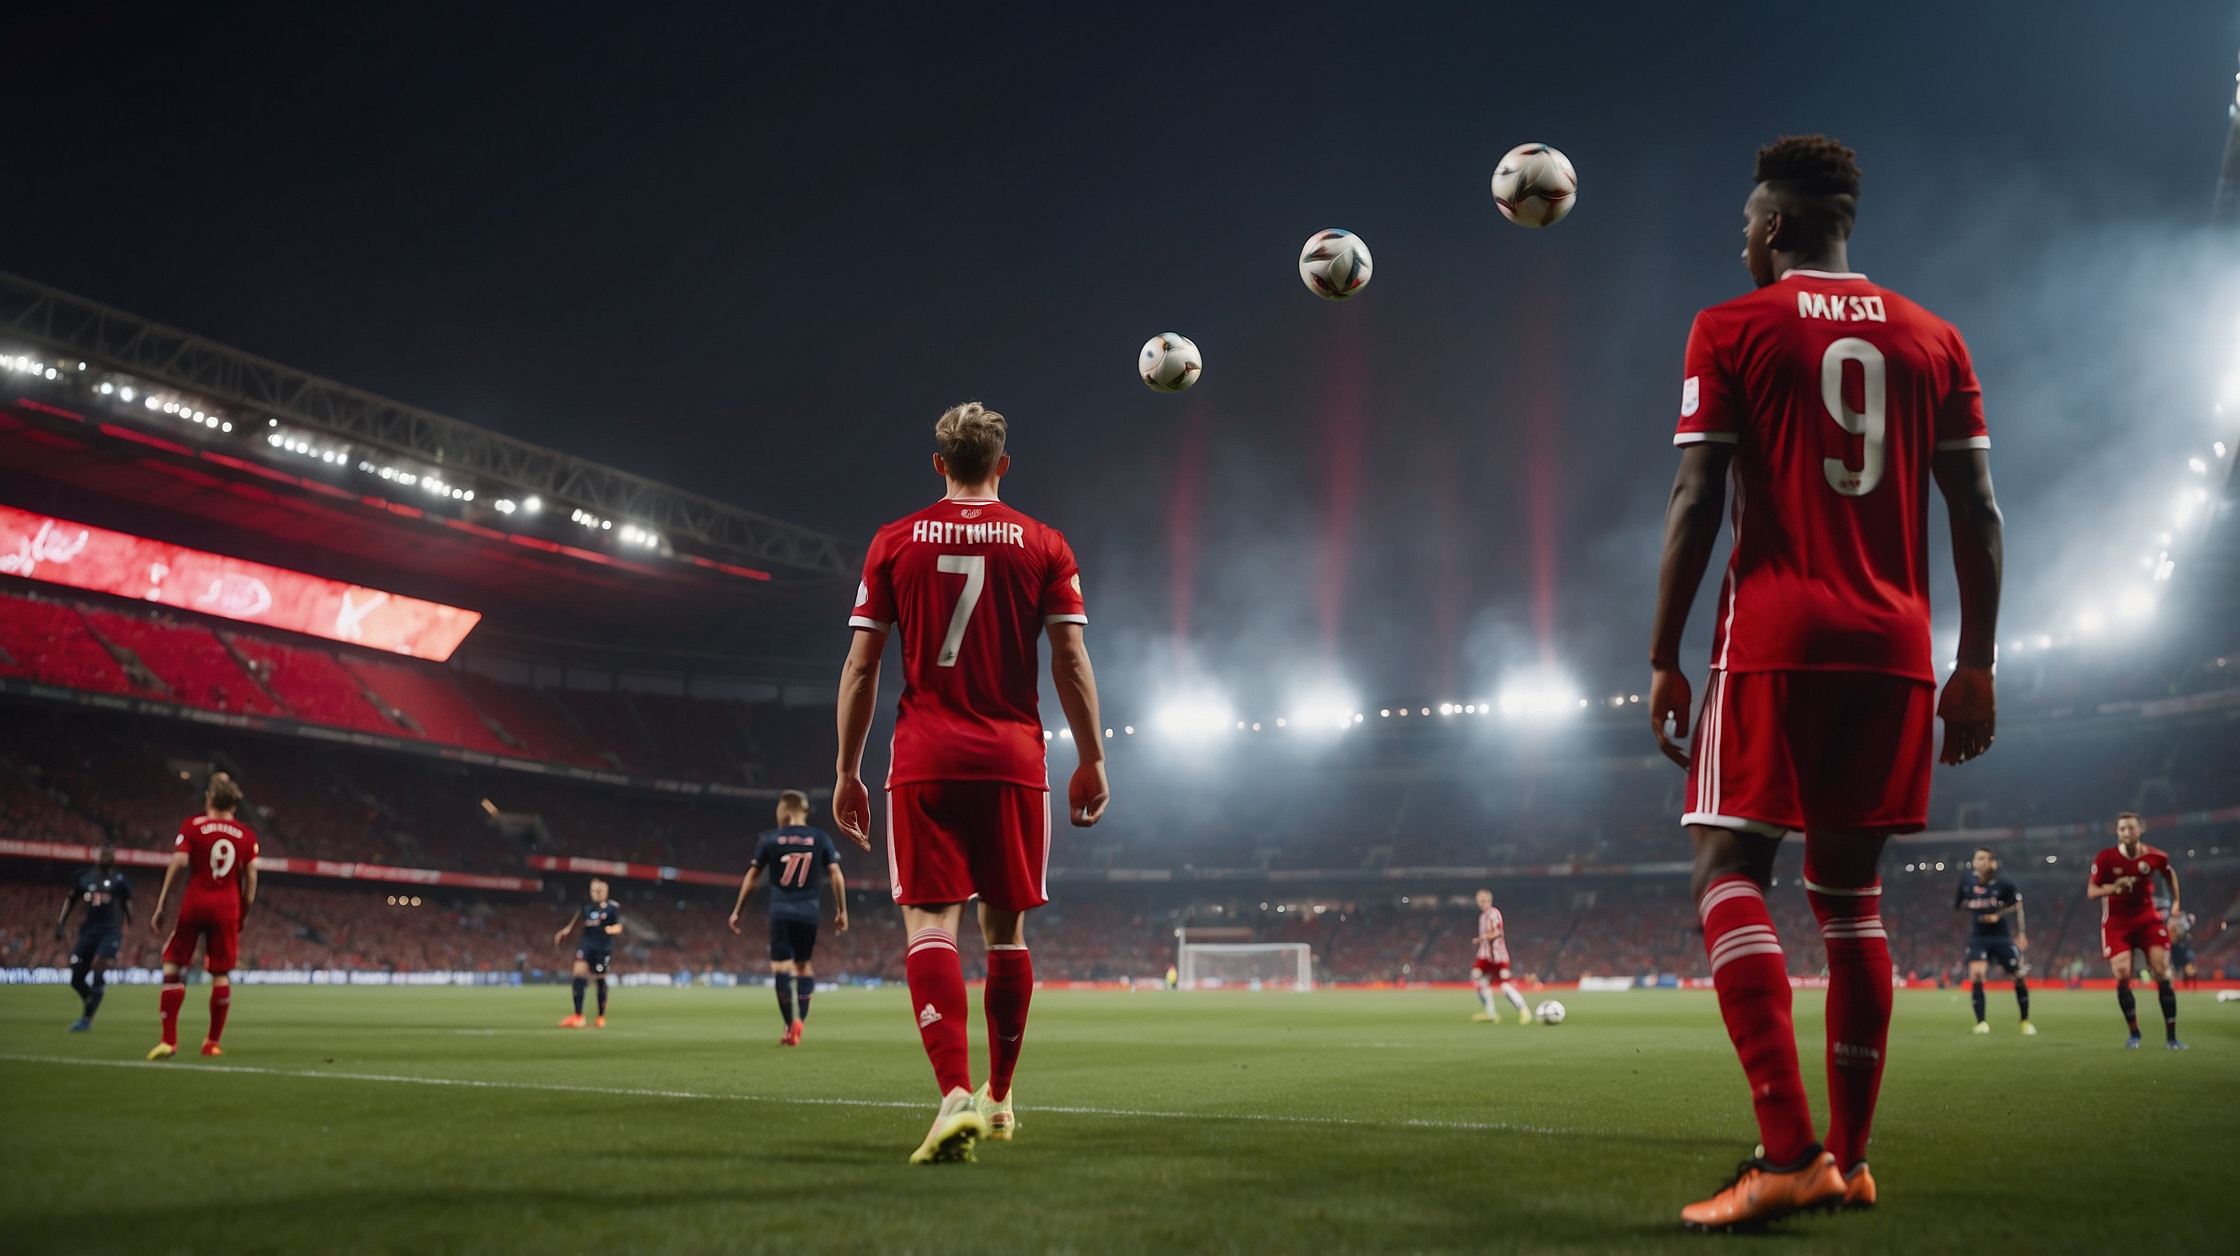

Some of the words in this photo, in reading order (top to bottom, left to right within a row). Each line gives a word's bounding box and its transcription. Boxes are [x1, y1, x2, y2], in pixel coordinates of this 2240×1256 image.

[1821, 337, 1886, 496] 9
[937, 554, 986, 667] 7
[209, 838, 236, 880] 9
